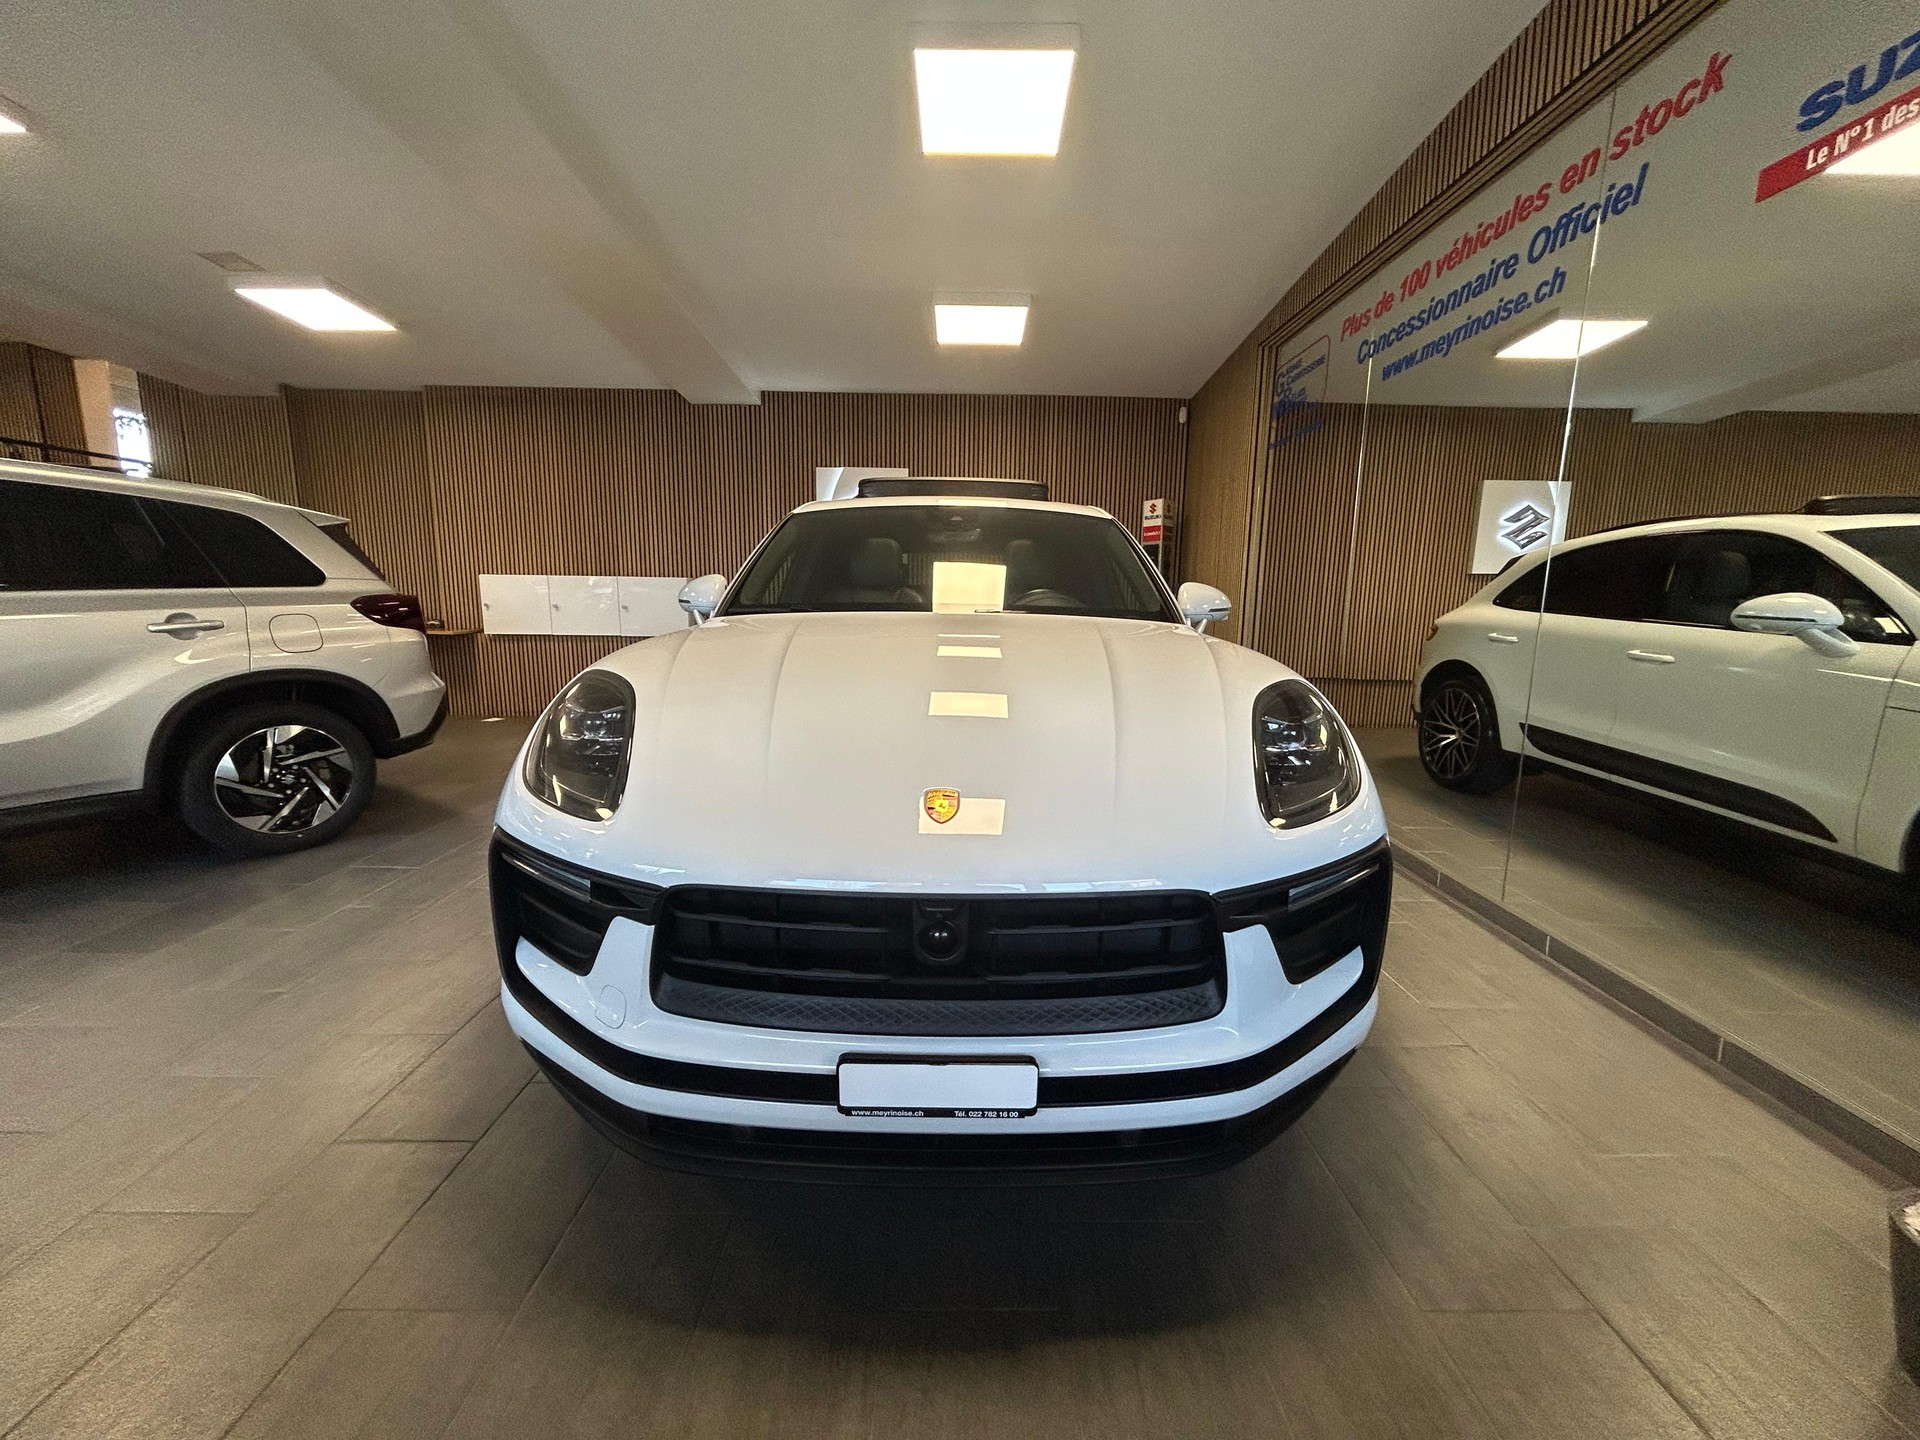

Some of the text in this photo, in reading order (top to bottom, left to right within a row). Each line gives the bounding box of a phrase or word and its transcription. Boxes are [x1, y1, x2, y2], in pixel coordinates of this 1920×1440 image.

[1806, 145, 1828, 170] Le
[1881, 97, 1920, 131] des
[1341, 51, 1733, 342] Plus de 100 véhicules en stock
[1357, 161, 1650, 364] Concessionnaire Officiel
[1382, 266, 1567, 381] www.meyrinoise.ch
[851, 1109, 924, 1117] www.meyrinoise.ch
